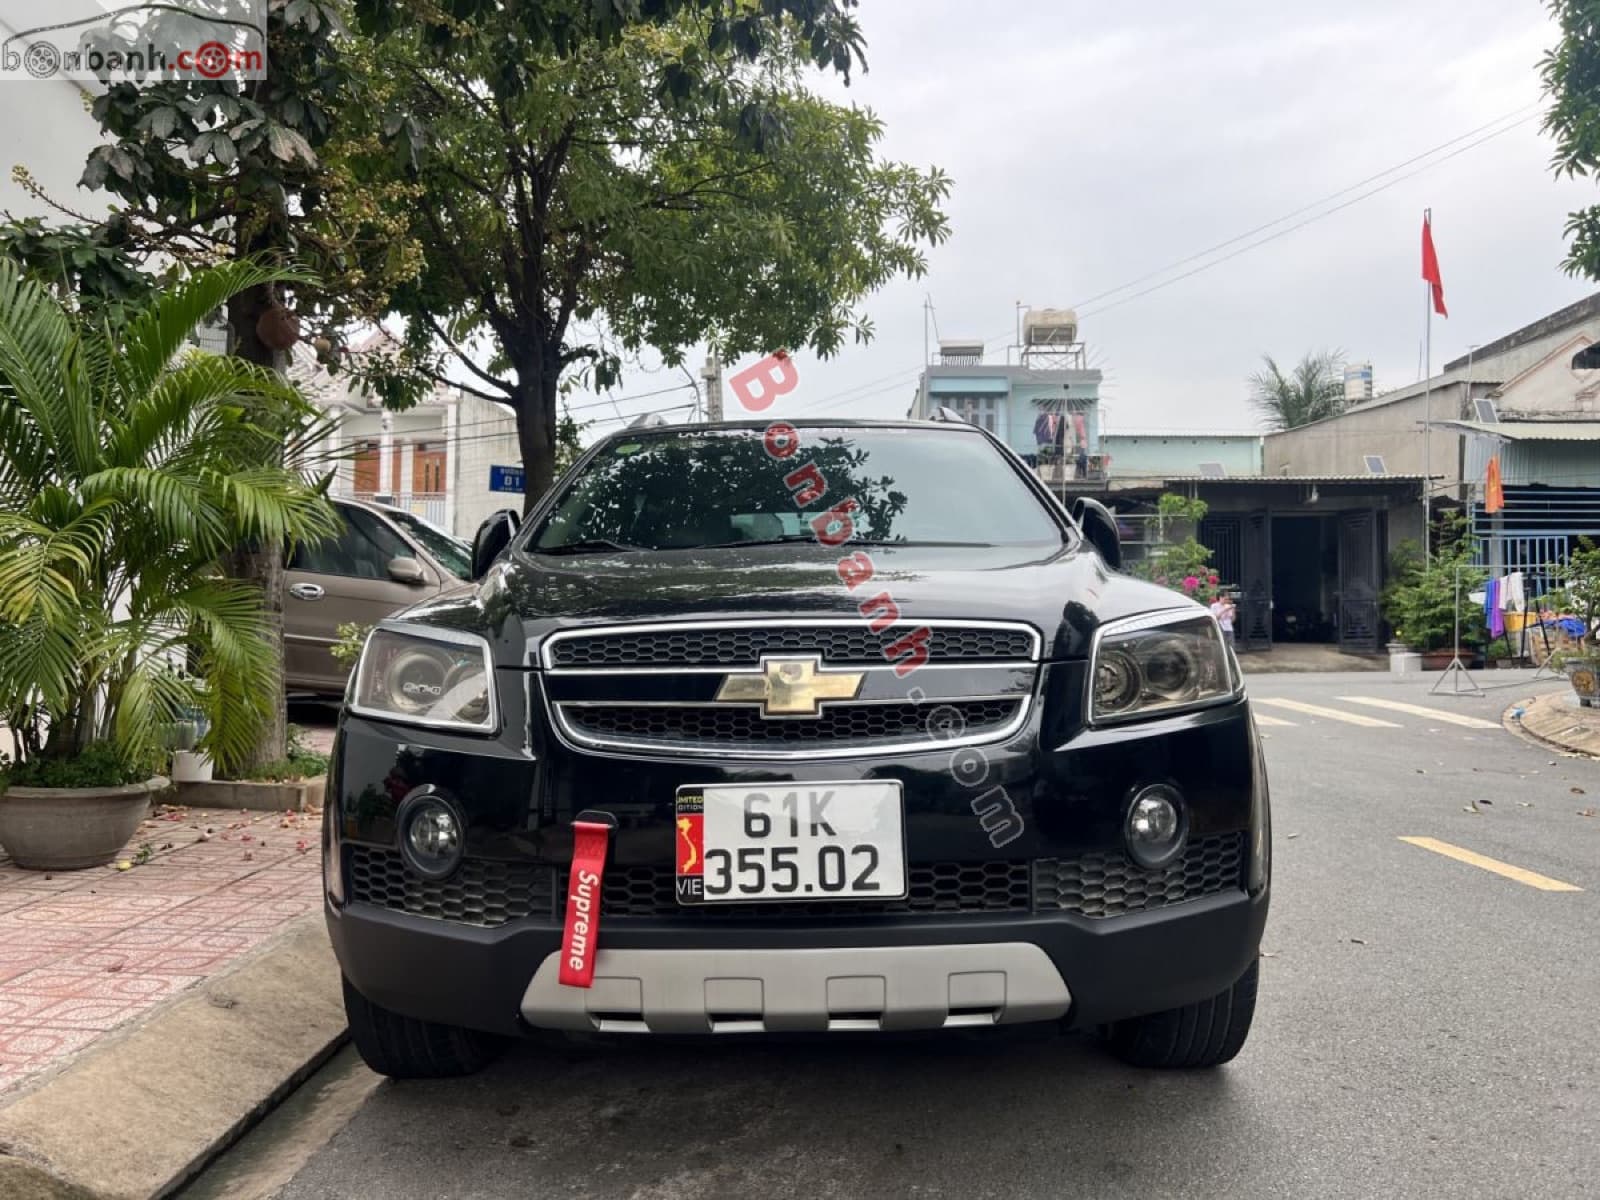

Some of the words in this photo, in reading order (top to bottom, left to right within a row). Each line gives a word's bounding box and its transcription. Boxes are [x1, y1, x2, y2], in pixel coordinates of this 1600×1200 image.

[743, 791, 837, 838] 61K
[704, 845, 880, 895] 355.02
[568, 869, 599, 971] Supreme
